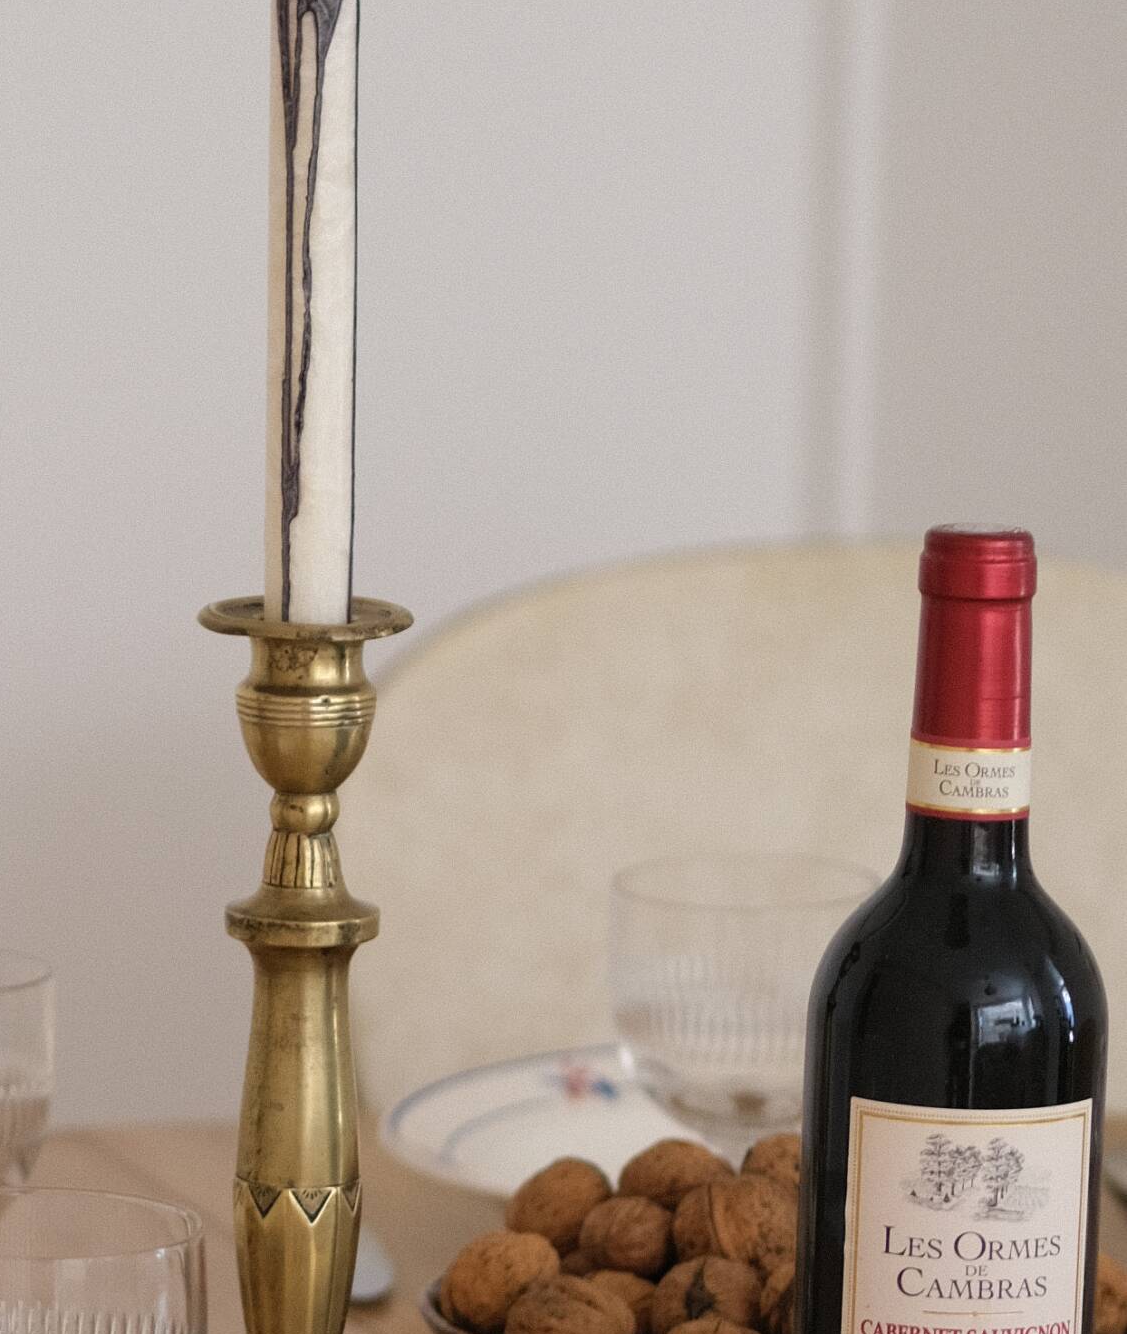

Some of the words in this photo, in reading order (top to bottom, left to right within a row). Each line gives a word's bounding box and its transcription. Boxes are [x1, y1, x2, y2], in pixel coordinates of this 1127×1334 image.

[934, 759, 961, 777] LES
[965, 762, 1016, 779] ORMES
[939, 779, 1009, 798] CAMBRAS
[883, 1225, 943, 1259] LES
[953, 1231, 1061, 1261] ORMES
[965, 1265, 989, 1277] DE
[896, 1267, 1047, 1301] CAMBRAS
